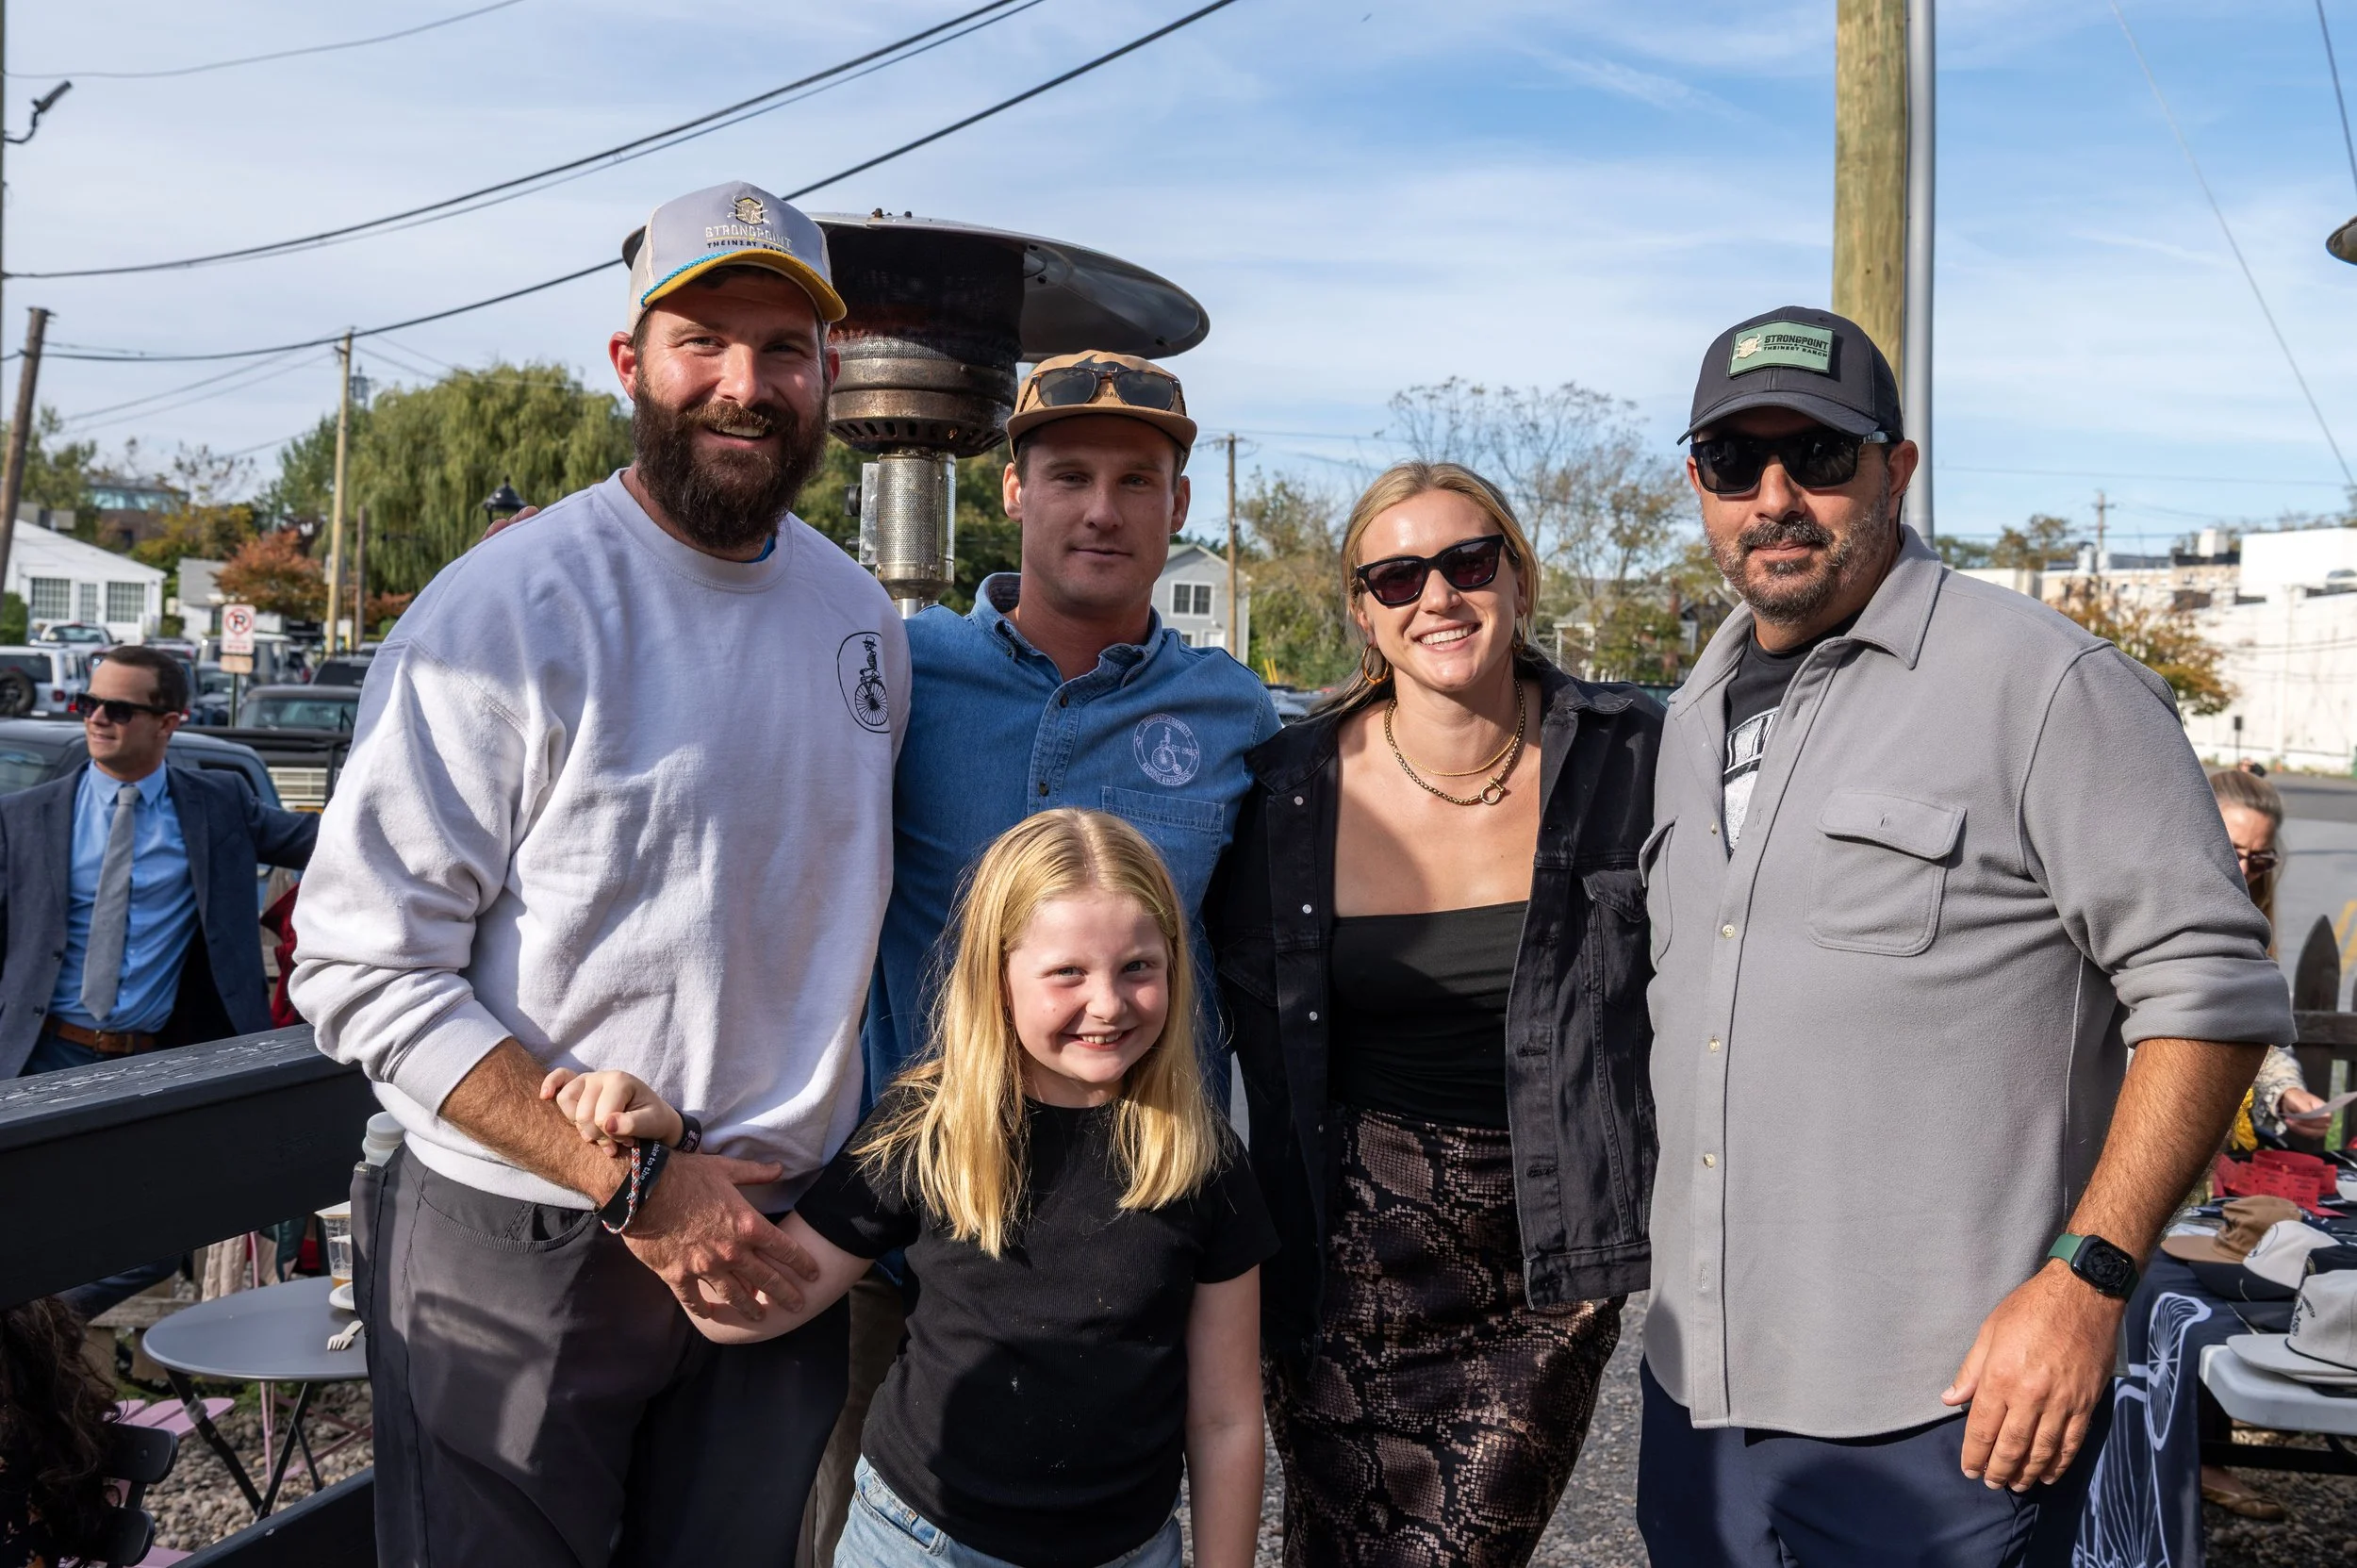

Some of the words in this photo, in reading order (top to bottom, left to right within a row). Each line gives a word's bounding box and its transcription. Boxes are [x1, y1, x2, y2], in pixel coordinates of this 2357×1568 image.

[705, 224, 792, 249] STRONGPOINT
[1764, 334, 1829, 350] STRONGPOINT
[1802, 349, 1828, 357] RANCH
[647, 1157, 656, 1166] to
[640, 1166, 651, 1180] the
